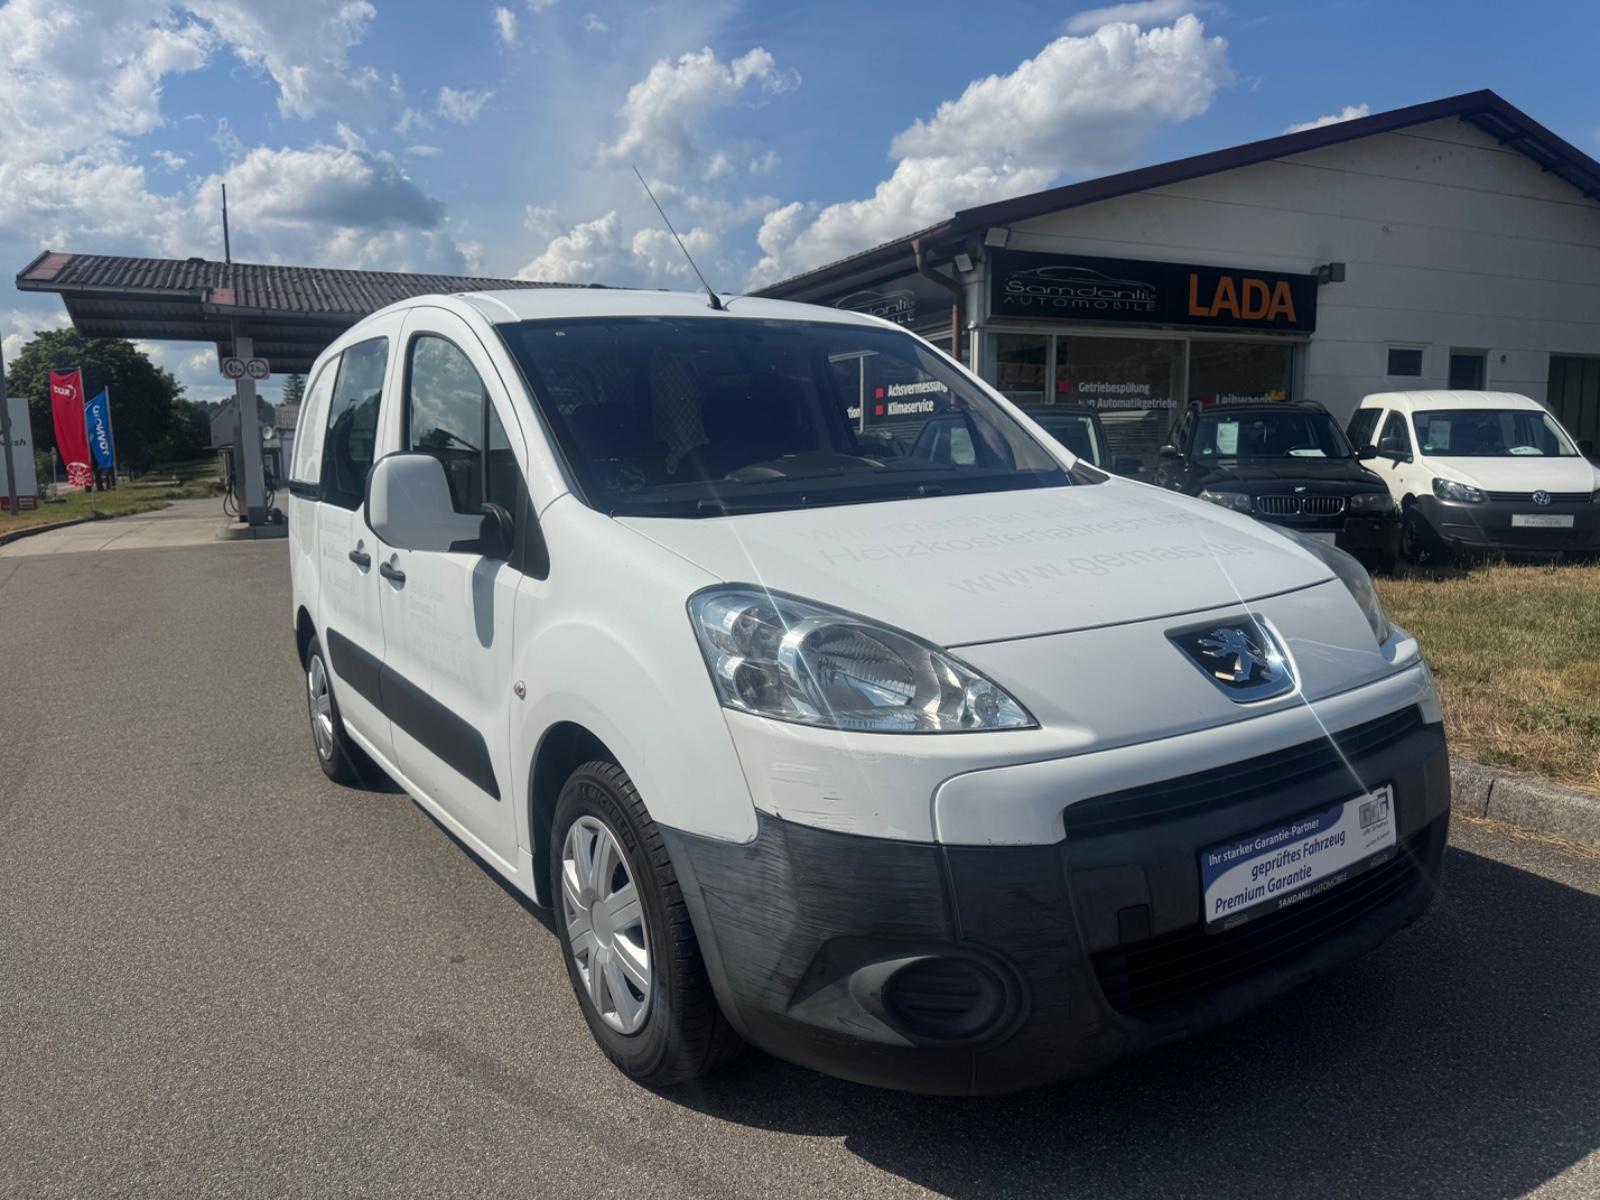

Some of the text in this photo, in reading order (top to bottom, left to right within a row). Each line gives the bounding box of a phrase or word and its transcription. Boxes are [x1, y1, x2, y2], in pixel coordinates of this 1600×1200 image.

[1003, 296, 1157, 312] AUTOMOBILE
[1187, 273, 1297, 323] LADA
[887, 398, 935, 416] Klimaservice
[1079, 382, 1151, 395] Getriebespülung
[1097, 397, 1178, 410] Automatikgetriebe
[944, 541, 1256, 598] www.gemas.de
[1208, 818, 1320, 867] Ihr starker Garantie-Partner
[1251, 848, 1302, 882] geprüftes
[1302, 829, 1347, 858] Fahrzeug
[1215, 864, 1313, 914] Premium Garantie
